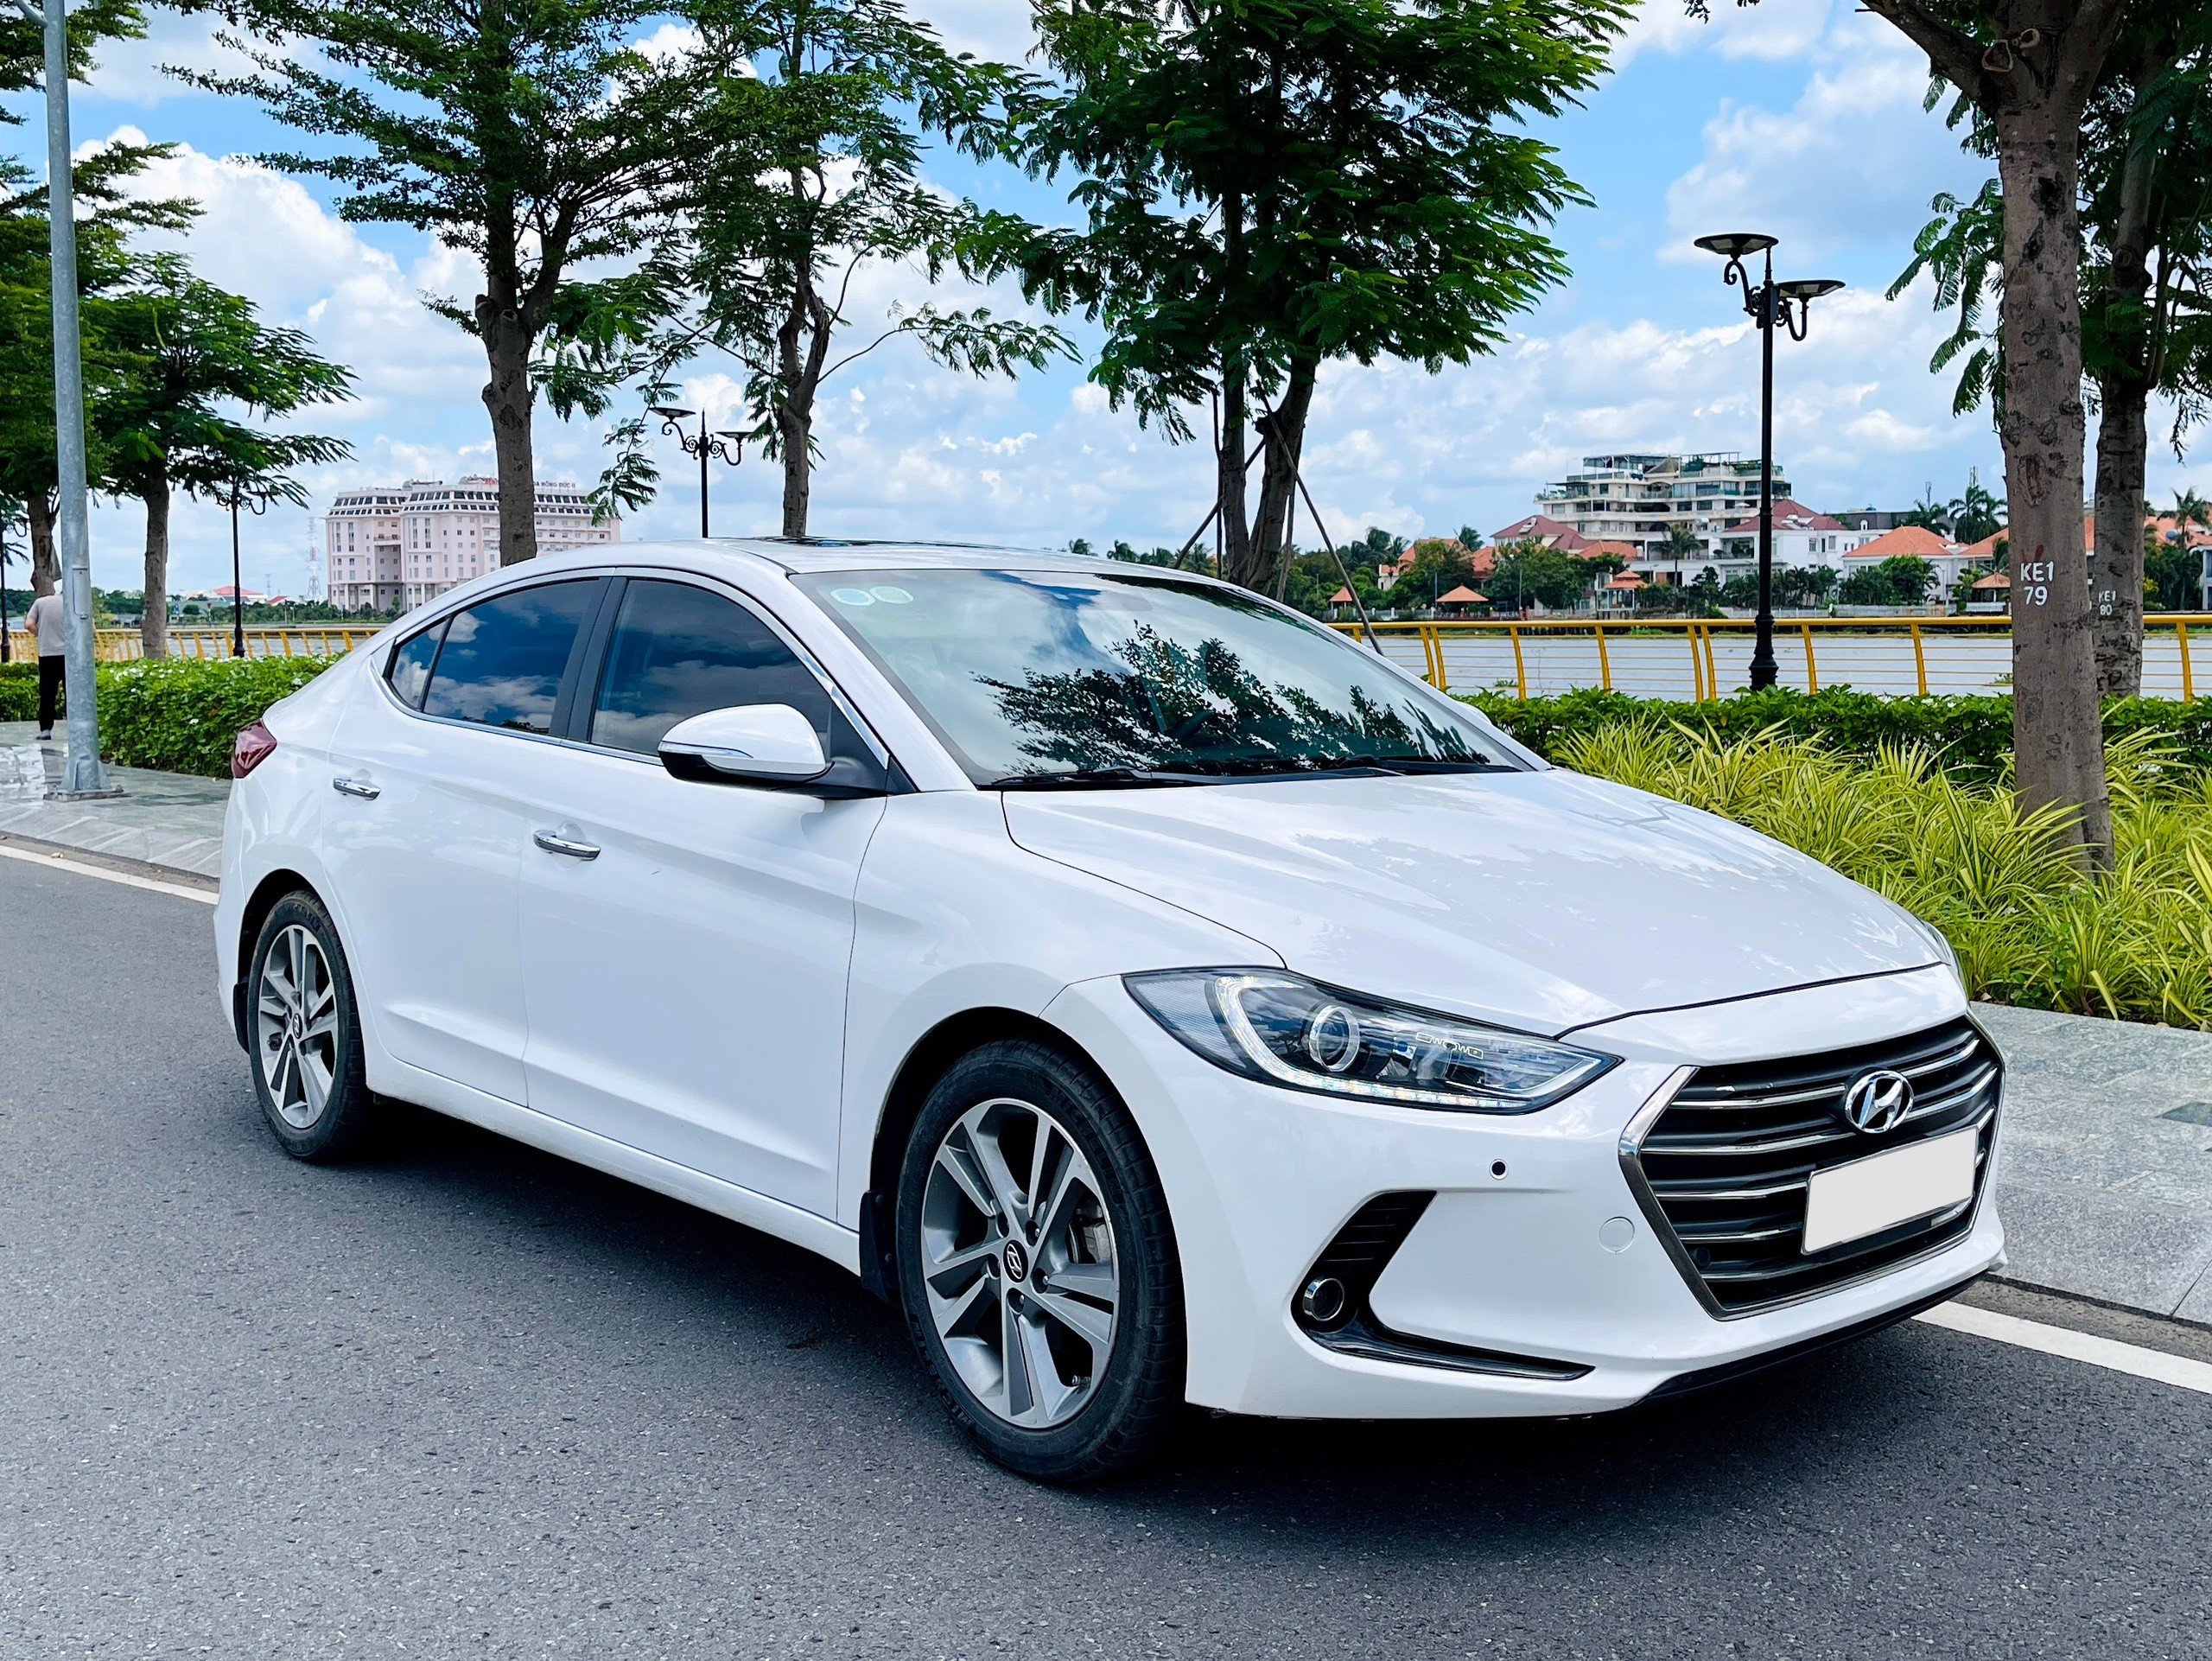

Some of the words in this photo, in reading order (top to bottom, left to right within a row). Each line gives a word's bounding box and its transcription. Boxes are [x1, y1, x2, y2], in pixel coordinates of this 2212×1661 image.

[2020, 561, 2055, 582] KE1
[2024, 585, 2048, 606] 79
[2098, 589, 2116, 602] KE1
[2100, 604, 2113, 616] 80
